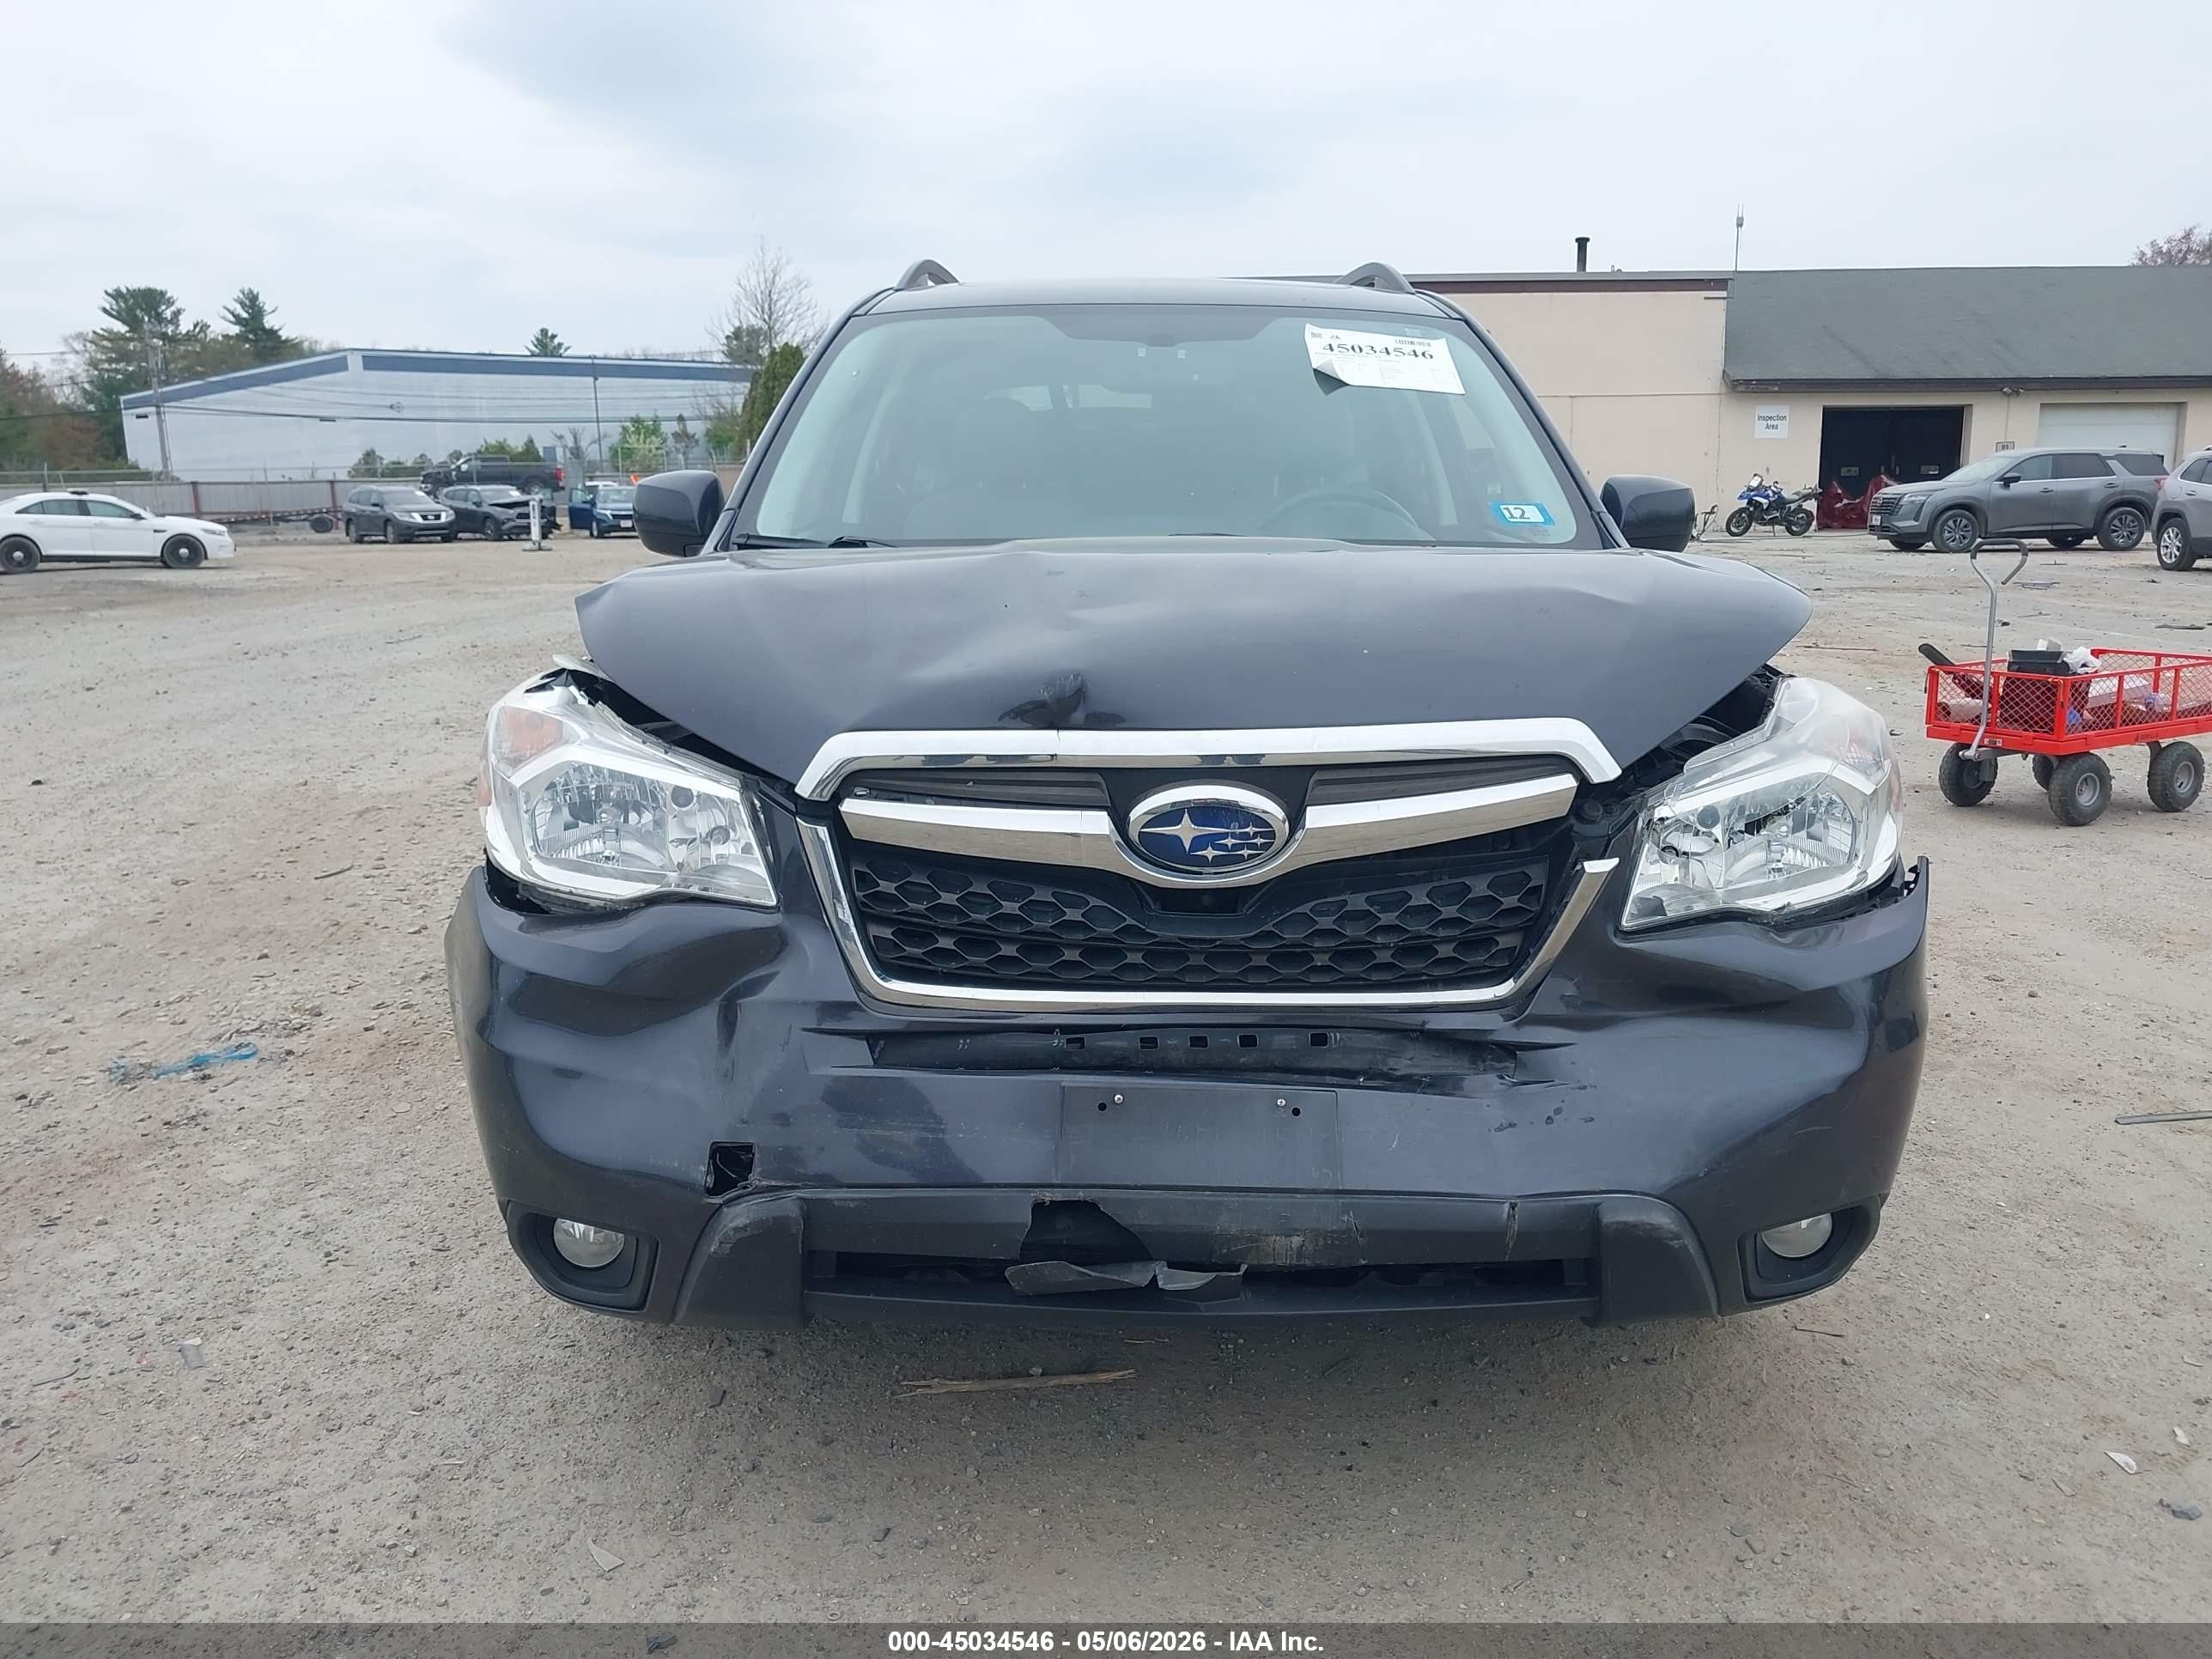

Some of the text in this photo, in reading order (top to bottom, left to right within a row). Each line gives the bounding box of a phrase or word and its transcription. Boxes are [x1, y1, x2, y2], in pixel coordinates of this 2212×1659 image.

[1322, 343, 1433, 360] 45034546
[1757, 413, 1787, 422] Inspection
[1503, 507, 1531, 520] 12
